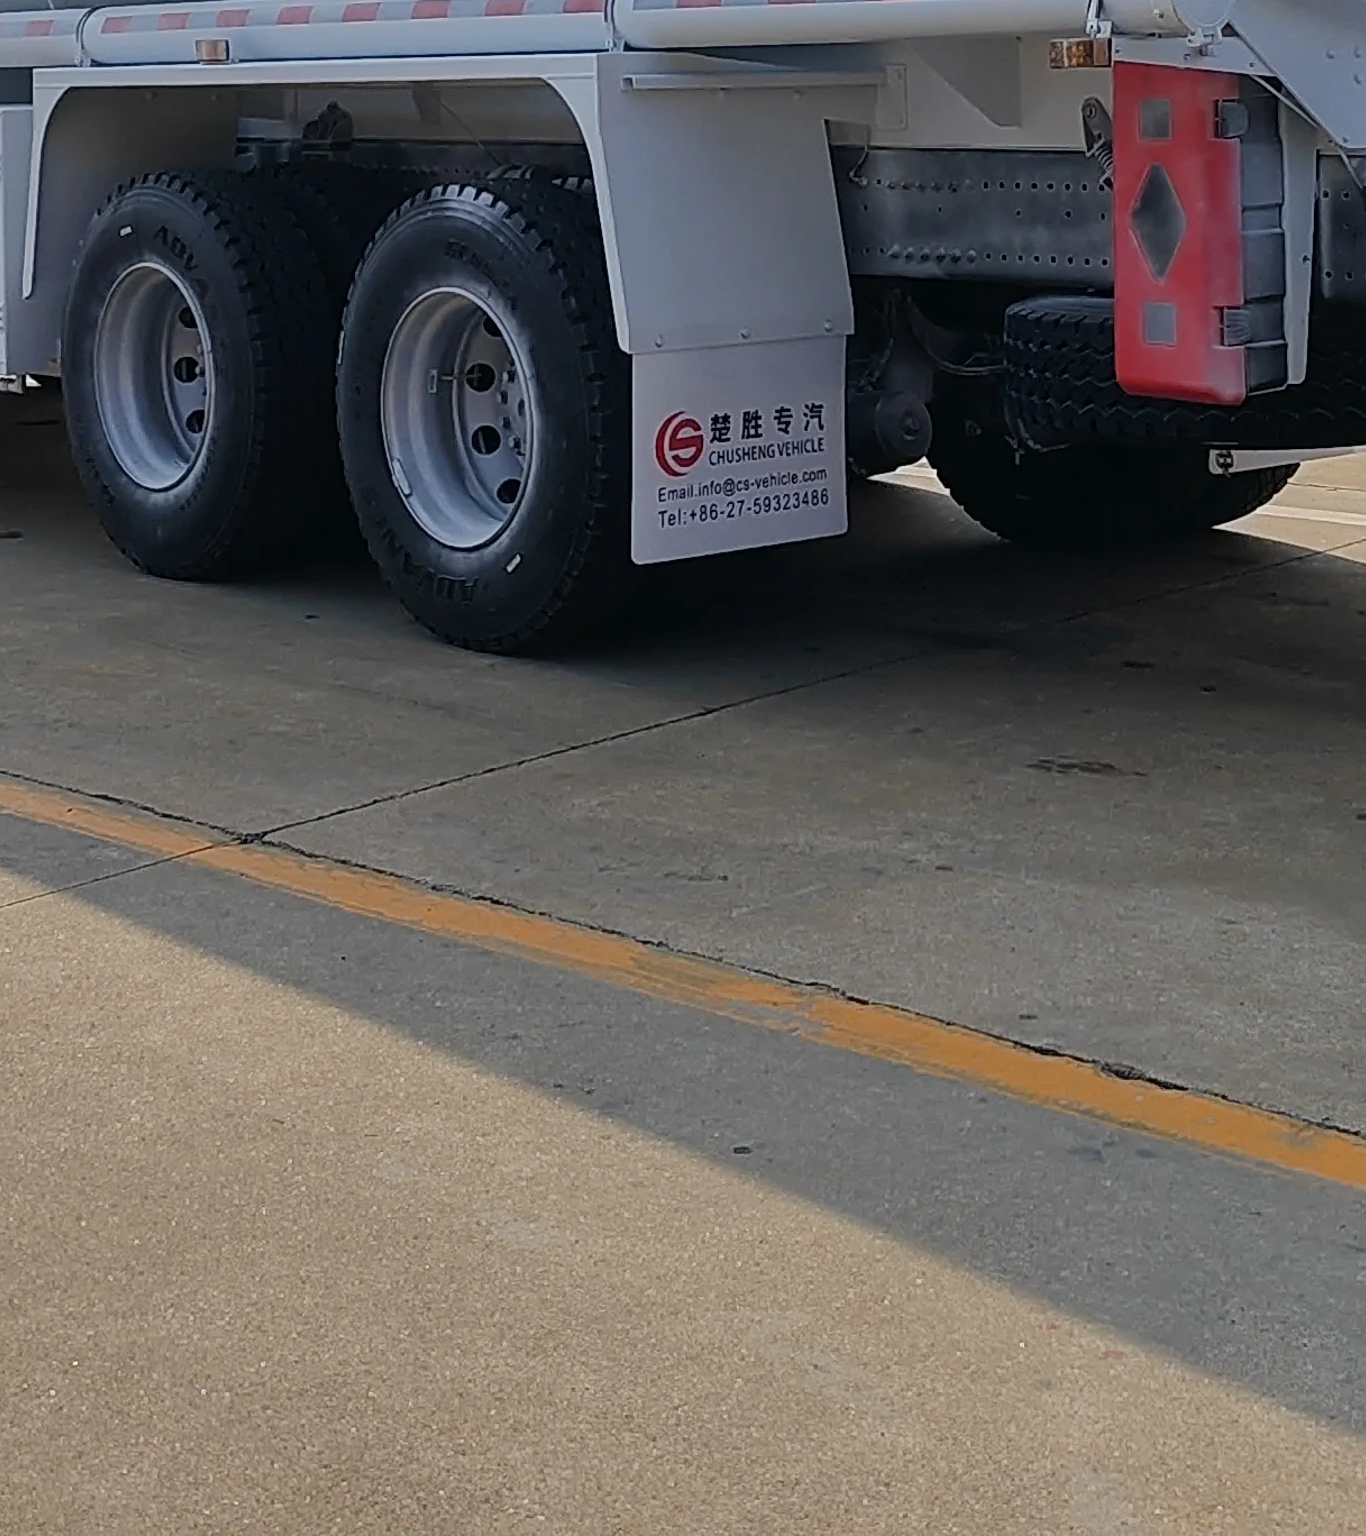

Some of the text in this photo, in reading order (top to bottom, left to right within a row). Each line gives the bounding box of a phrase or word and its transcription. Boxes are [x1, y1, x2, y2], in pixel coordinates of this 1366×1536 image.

[709, 402, 825, 444] 楚胜专汽
[708, 438, 825, 467] CHUSHENG VEHICLE
